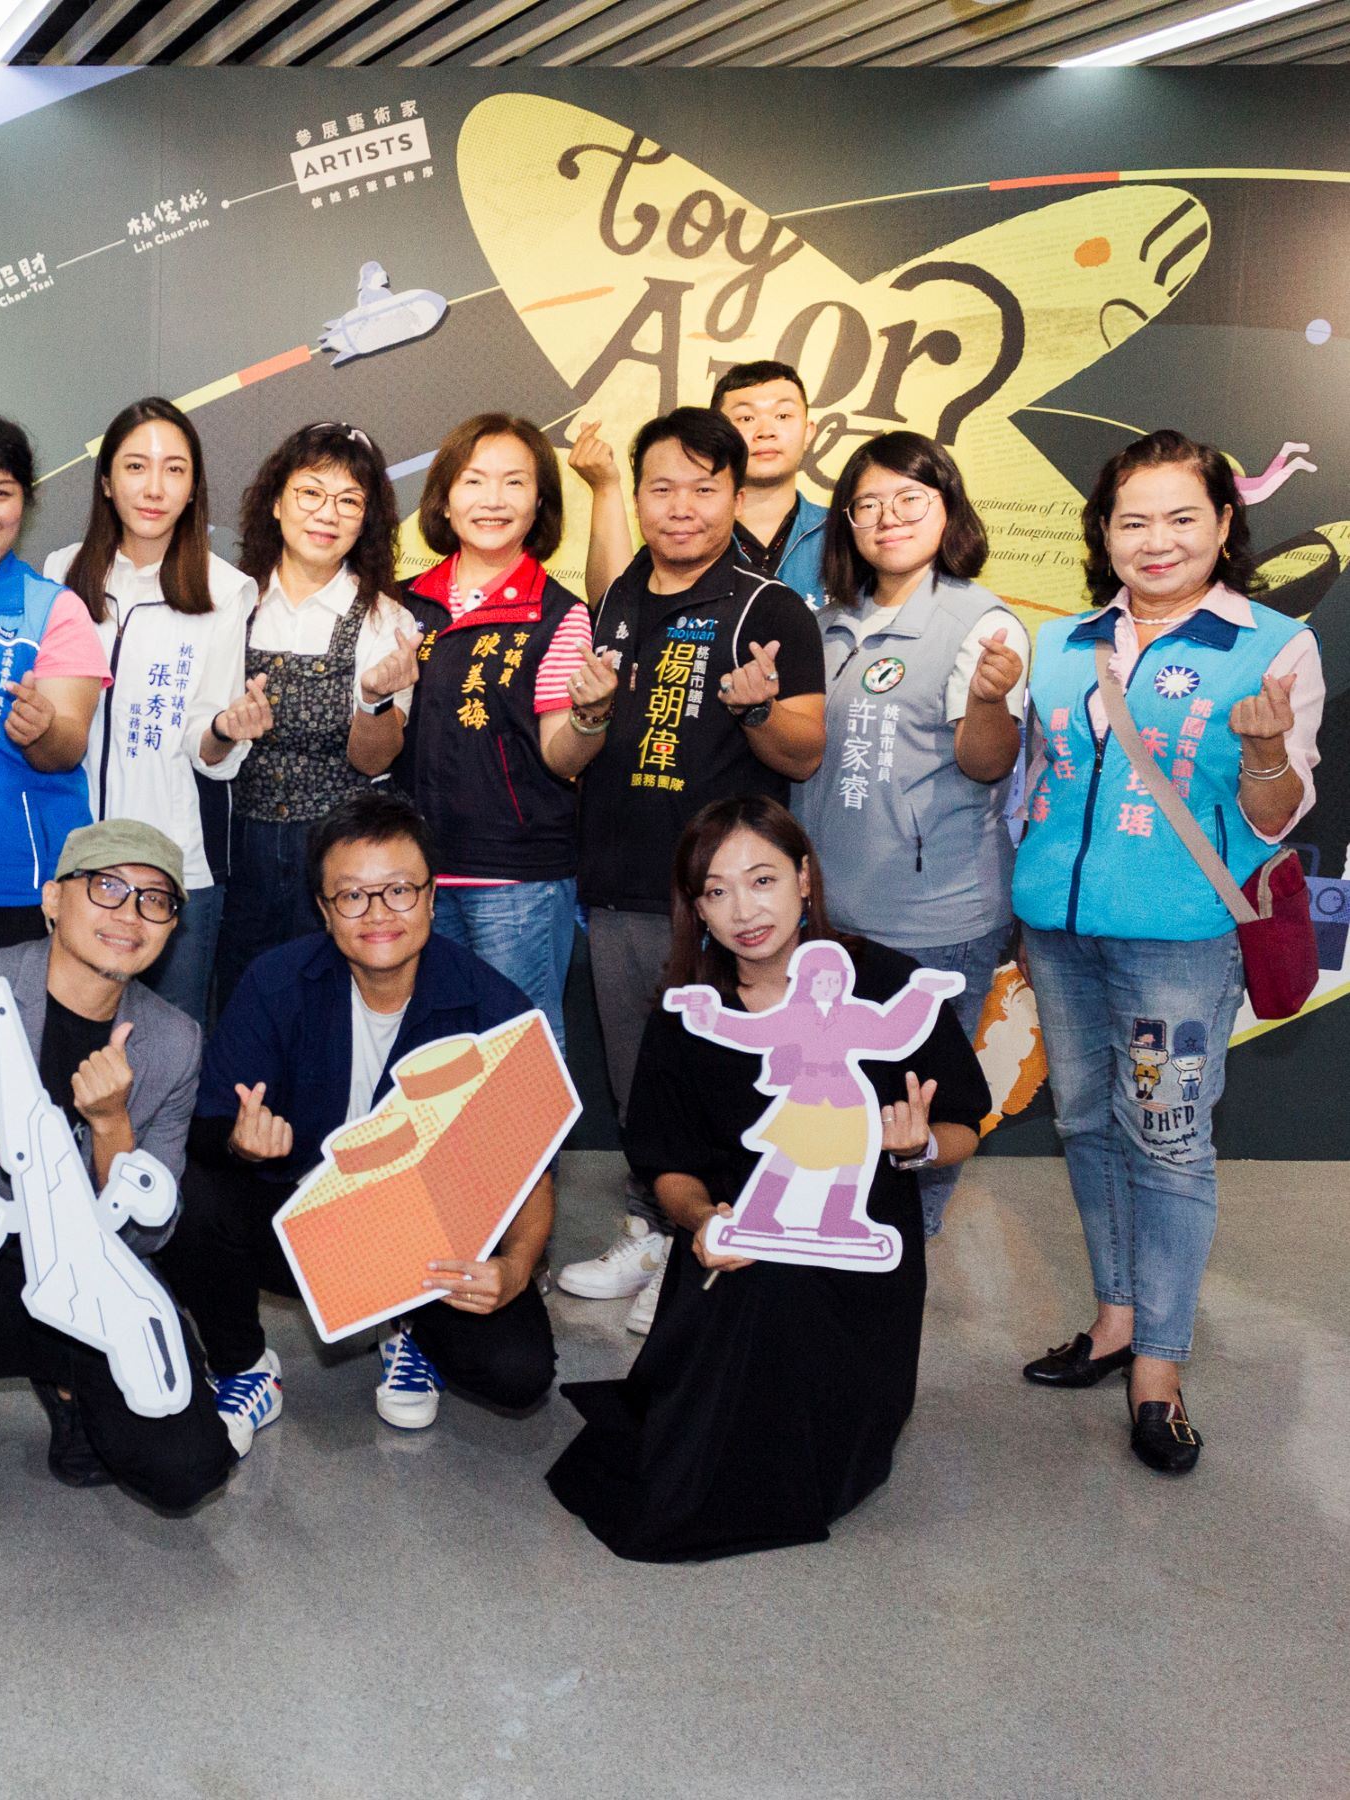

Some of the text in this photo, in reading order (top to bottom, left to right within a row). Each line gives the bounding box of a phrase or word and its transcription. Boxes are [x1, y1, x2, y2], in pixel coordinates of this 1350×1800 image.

[295, 100, 418, 147] 參展藝術家
[304, 133, 413, 179] ARTISTS
[133, 218, 210, 253] Lin Chun-Pin
[498, 631, 530, 688] 市議員
[666, 627, 716, 642] Taoyuan
[143, 663, 172, 750] 張秀菊
[170, 642, 195, 728] 桃園市議員
[638, 641, 697, 771] 楊朝偉
[684, 645, 711, 719] 桃園市議員
[126, 703, 142, 759] 服務團隊
[839, 697, 878, 810] 許家睿
[876, 703, 901, 783] 桃園市議員
[631, 773, 686, 791] 服務團隊
[1143, 1105, 1195, 1132] BHFD
